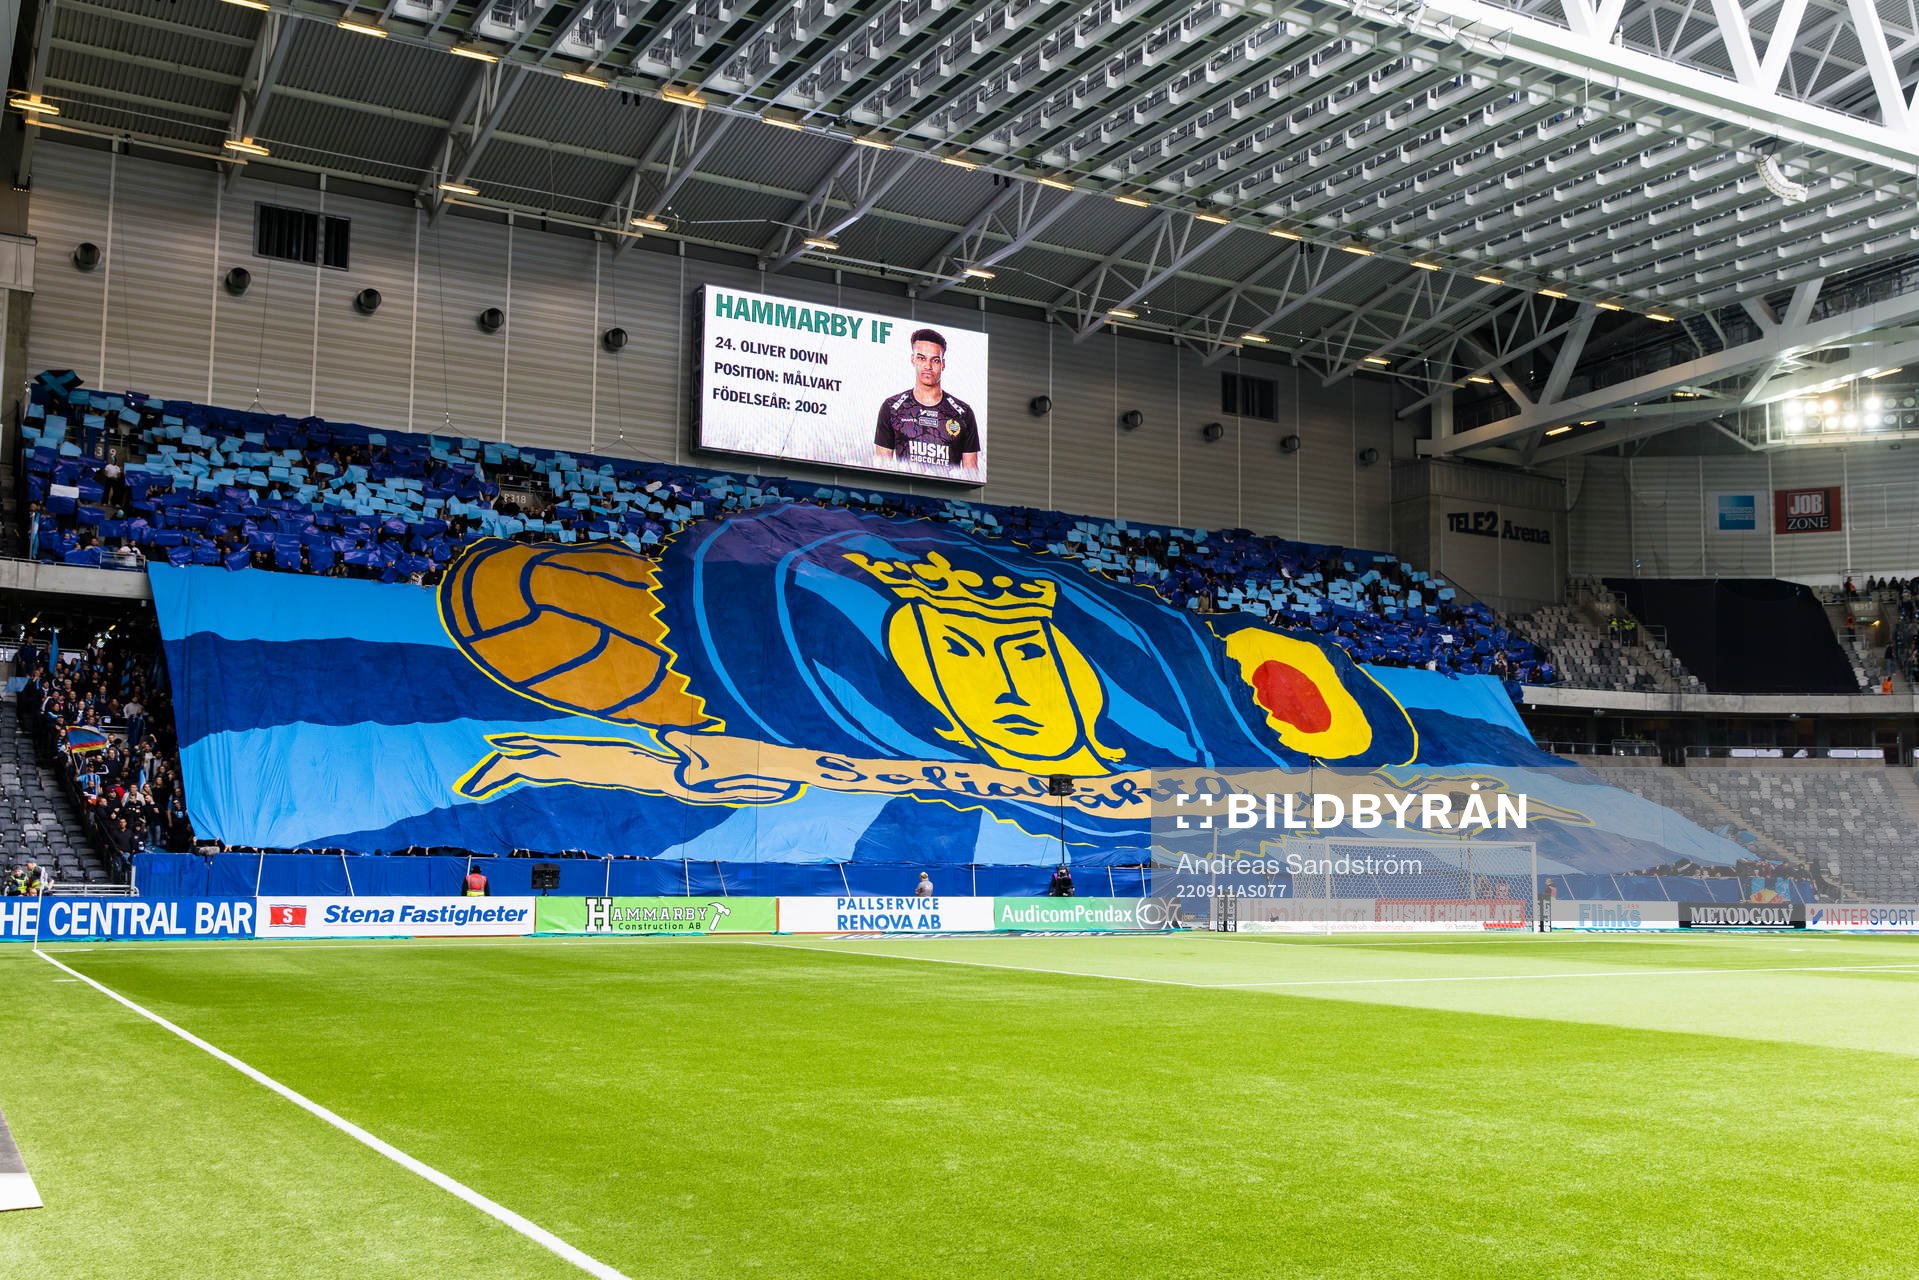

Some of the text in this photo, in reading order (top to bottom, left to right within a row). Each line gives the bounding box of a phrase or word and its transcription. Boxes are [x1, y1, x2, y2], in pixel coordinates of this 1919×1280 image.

[715, 293, 893, 344] HAMMARBY IF
[715, 336, 828, 365] 24. OLIVER DOVIN
[714, 361, 842, 392] POSITION: MÅLVAKT
[713, 385, 827, 415] FÖDELSEÅR: 2002
[908, 440, 950, 460] HUSKI
[910, 455, 950, 467] CHOCOLATE
[1789, 494, 1823, 515] JOB
[1447, 510, 1551, 544] TELE2 Arena
[1787, 516, 1830, 530] ZONE
[586, 897, 708, 932] HAMMARBY
[837, 898, 939, 910] PALLSERVICE
[1001, 905, 1133, 923] AudicomPendax
[49, 902, 187, 935] CENTRAL
[195, 901, 252, 935] BAR
[324, 905, 528, 926] Stena Fastigheter
[618, 922, 701, 930] Construction AB
[837, 914, 942, 930] RENOVA AB
[1579, 904, 1642, 927] Flinks
[1689, 907, 1794, 925] METODGOLV
[1825, 908, 1916, 926] INTERSPORT
